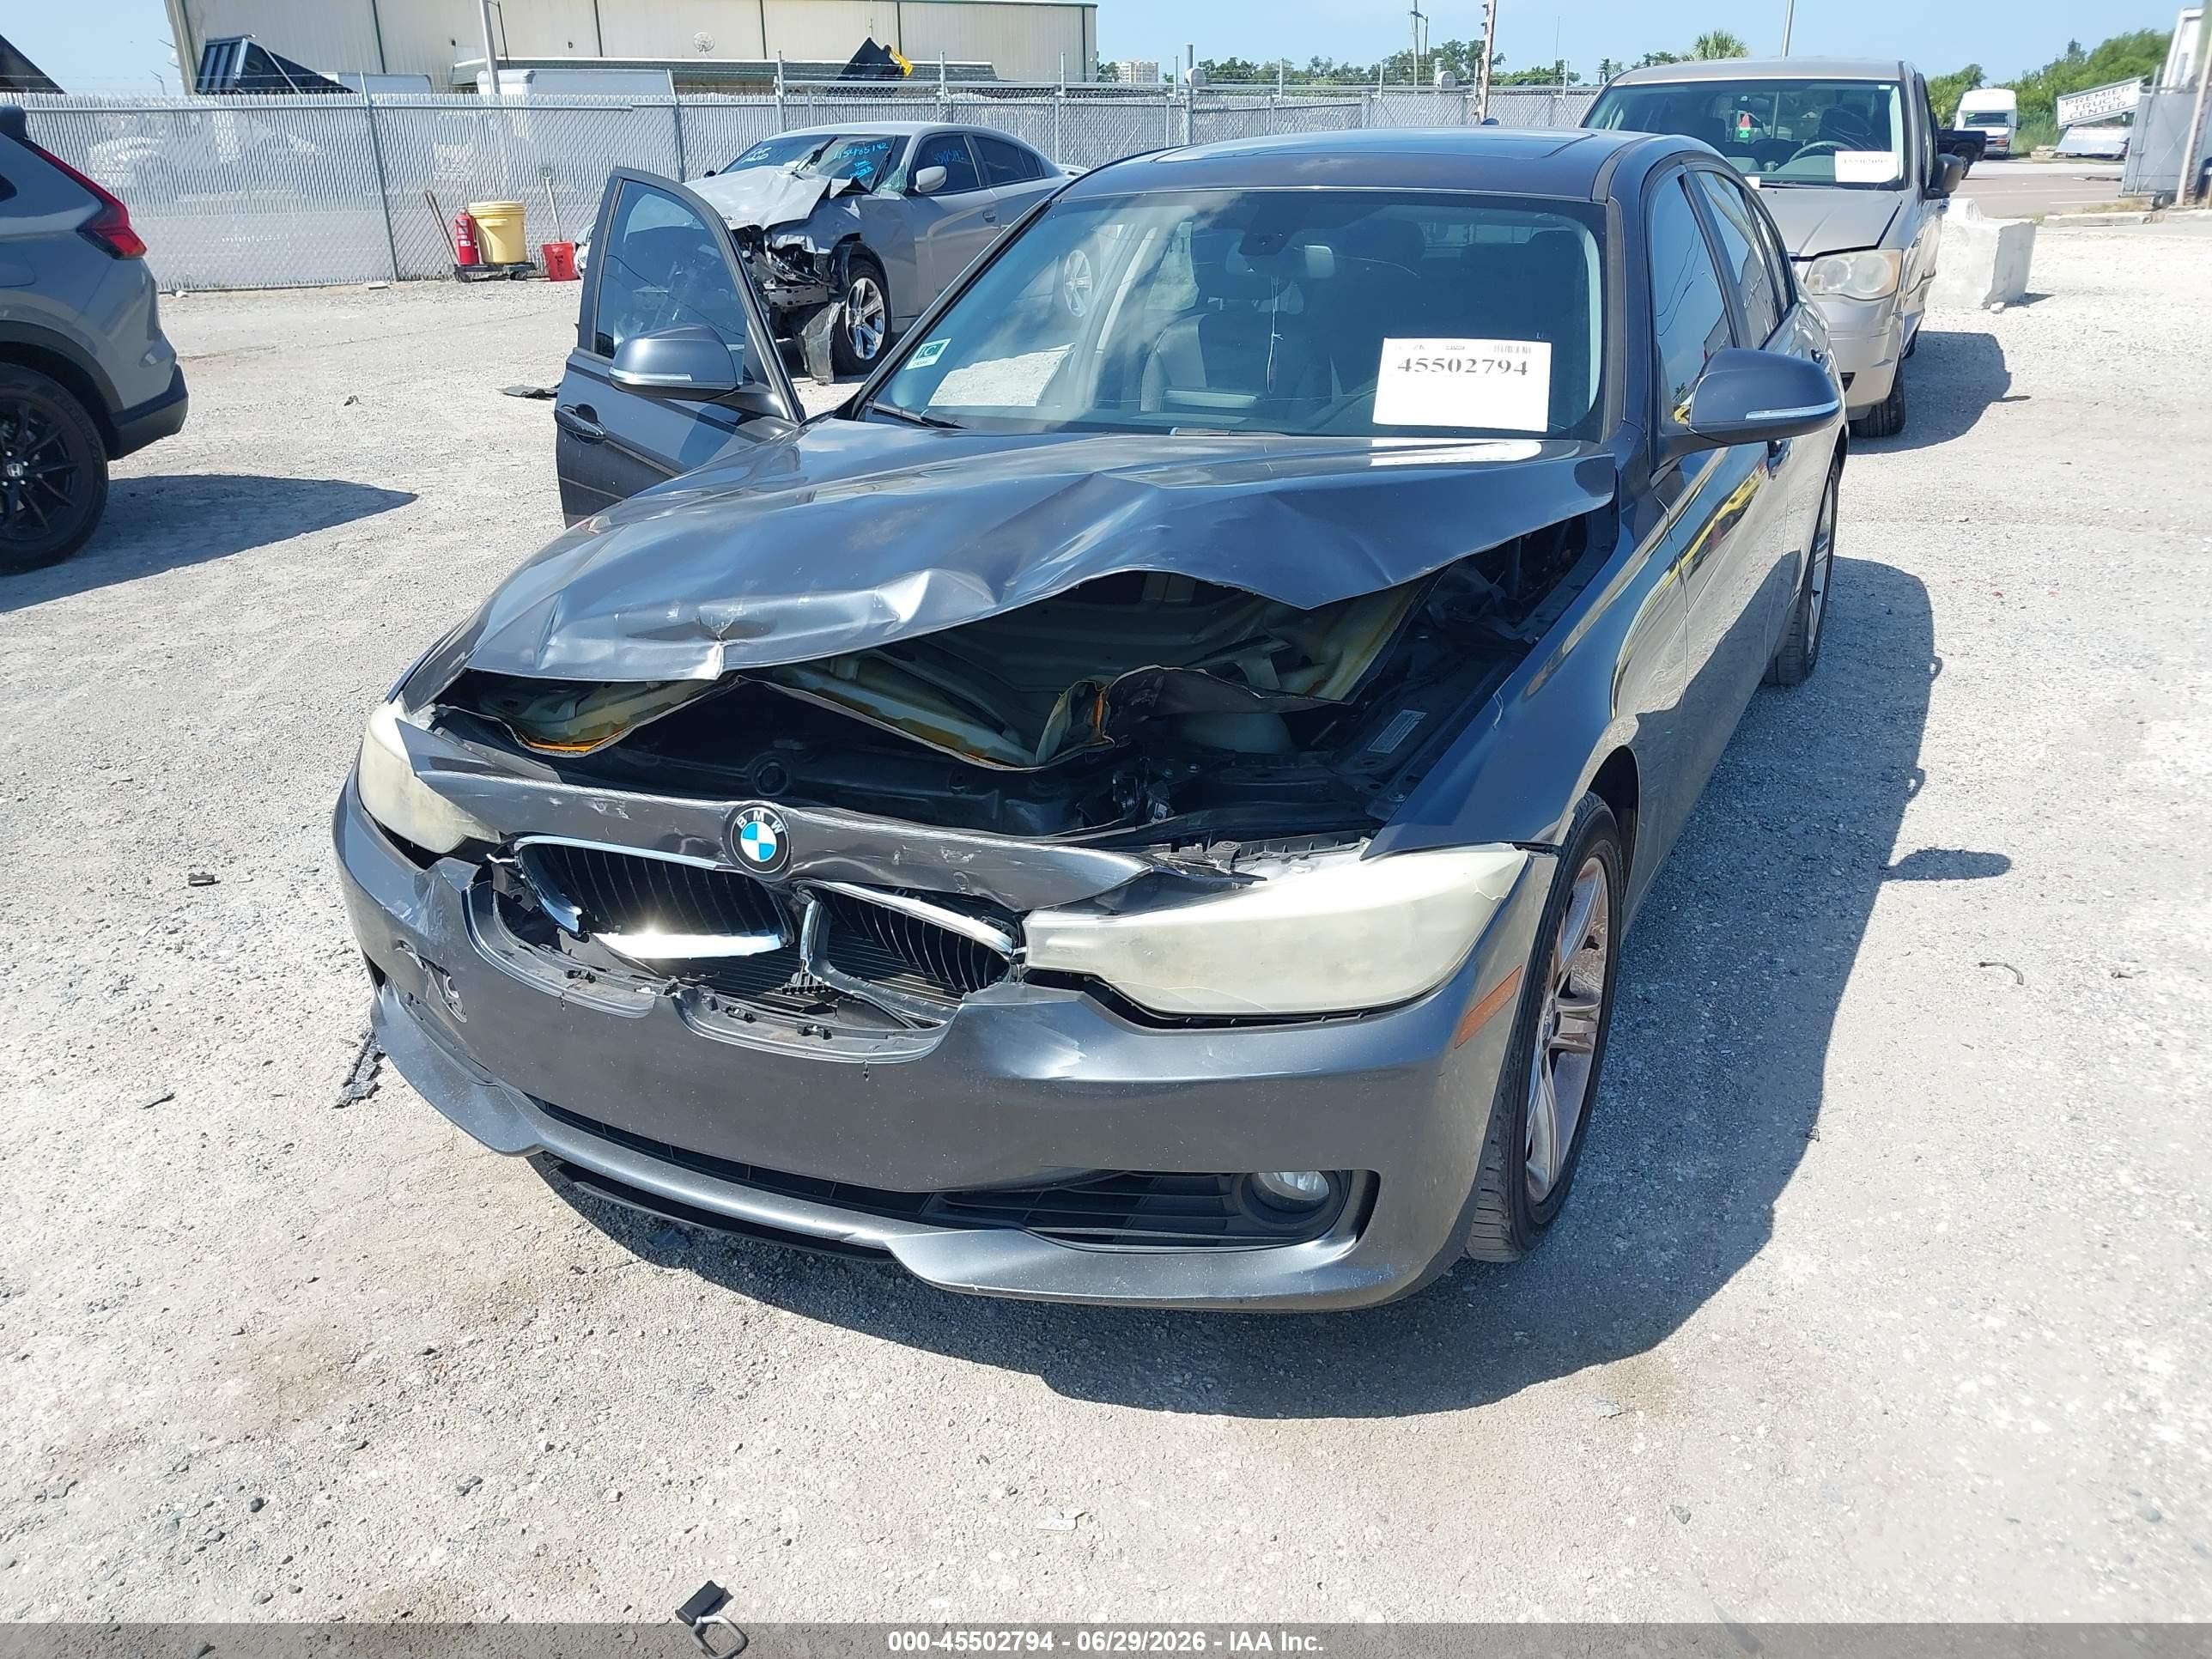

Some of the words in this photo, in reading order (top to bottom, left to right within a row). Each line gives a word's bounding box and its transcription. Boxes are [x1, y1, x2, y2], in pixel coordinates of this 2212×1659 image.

[2065, 87, 2130, 106] PREMIER
[2075, 95, 2123, 111] TRUCK
[2069, 100, 2126, 119] CENTER
[1397, 357, 1528, 375] 45502794
[736, 810, 784, 834] BMW
